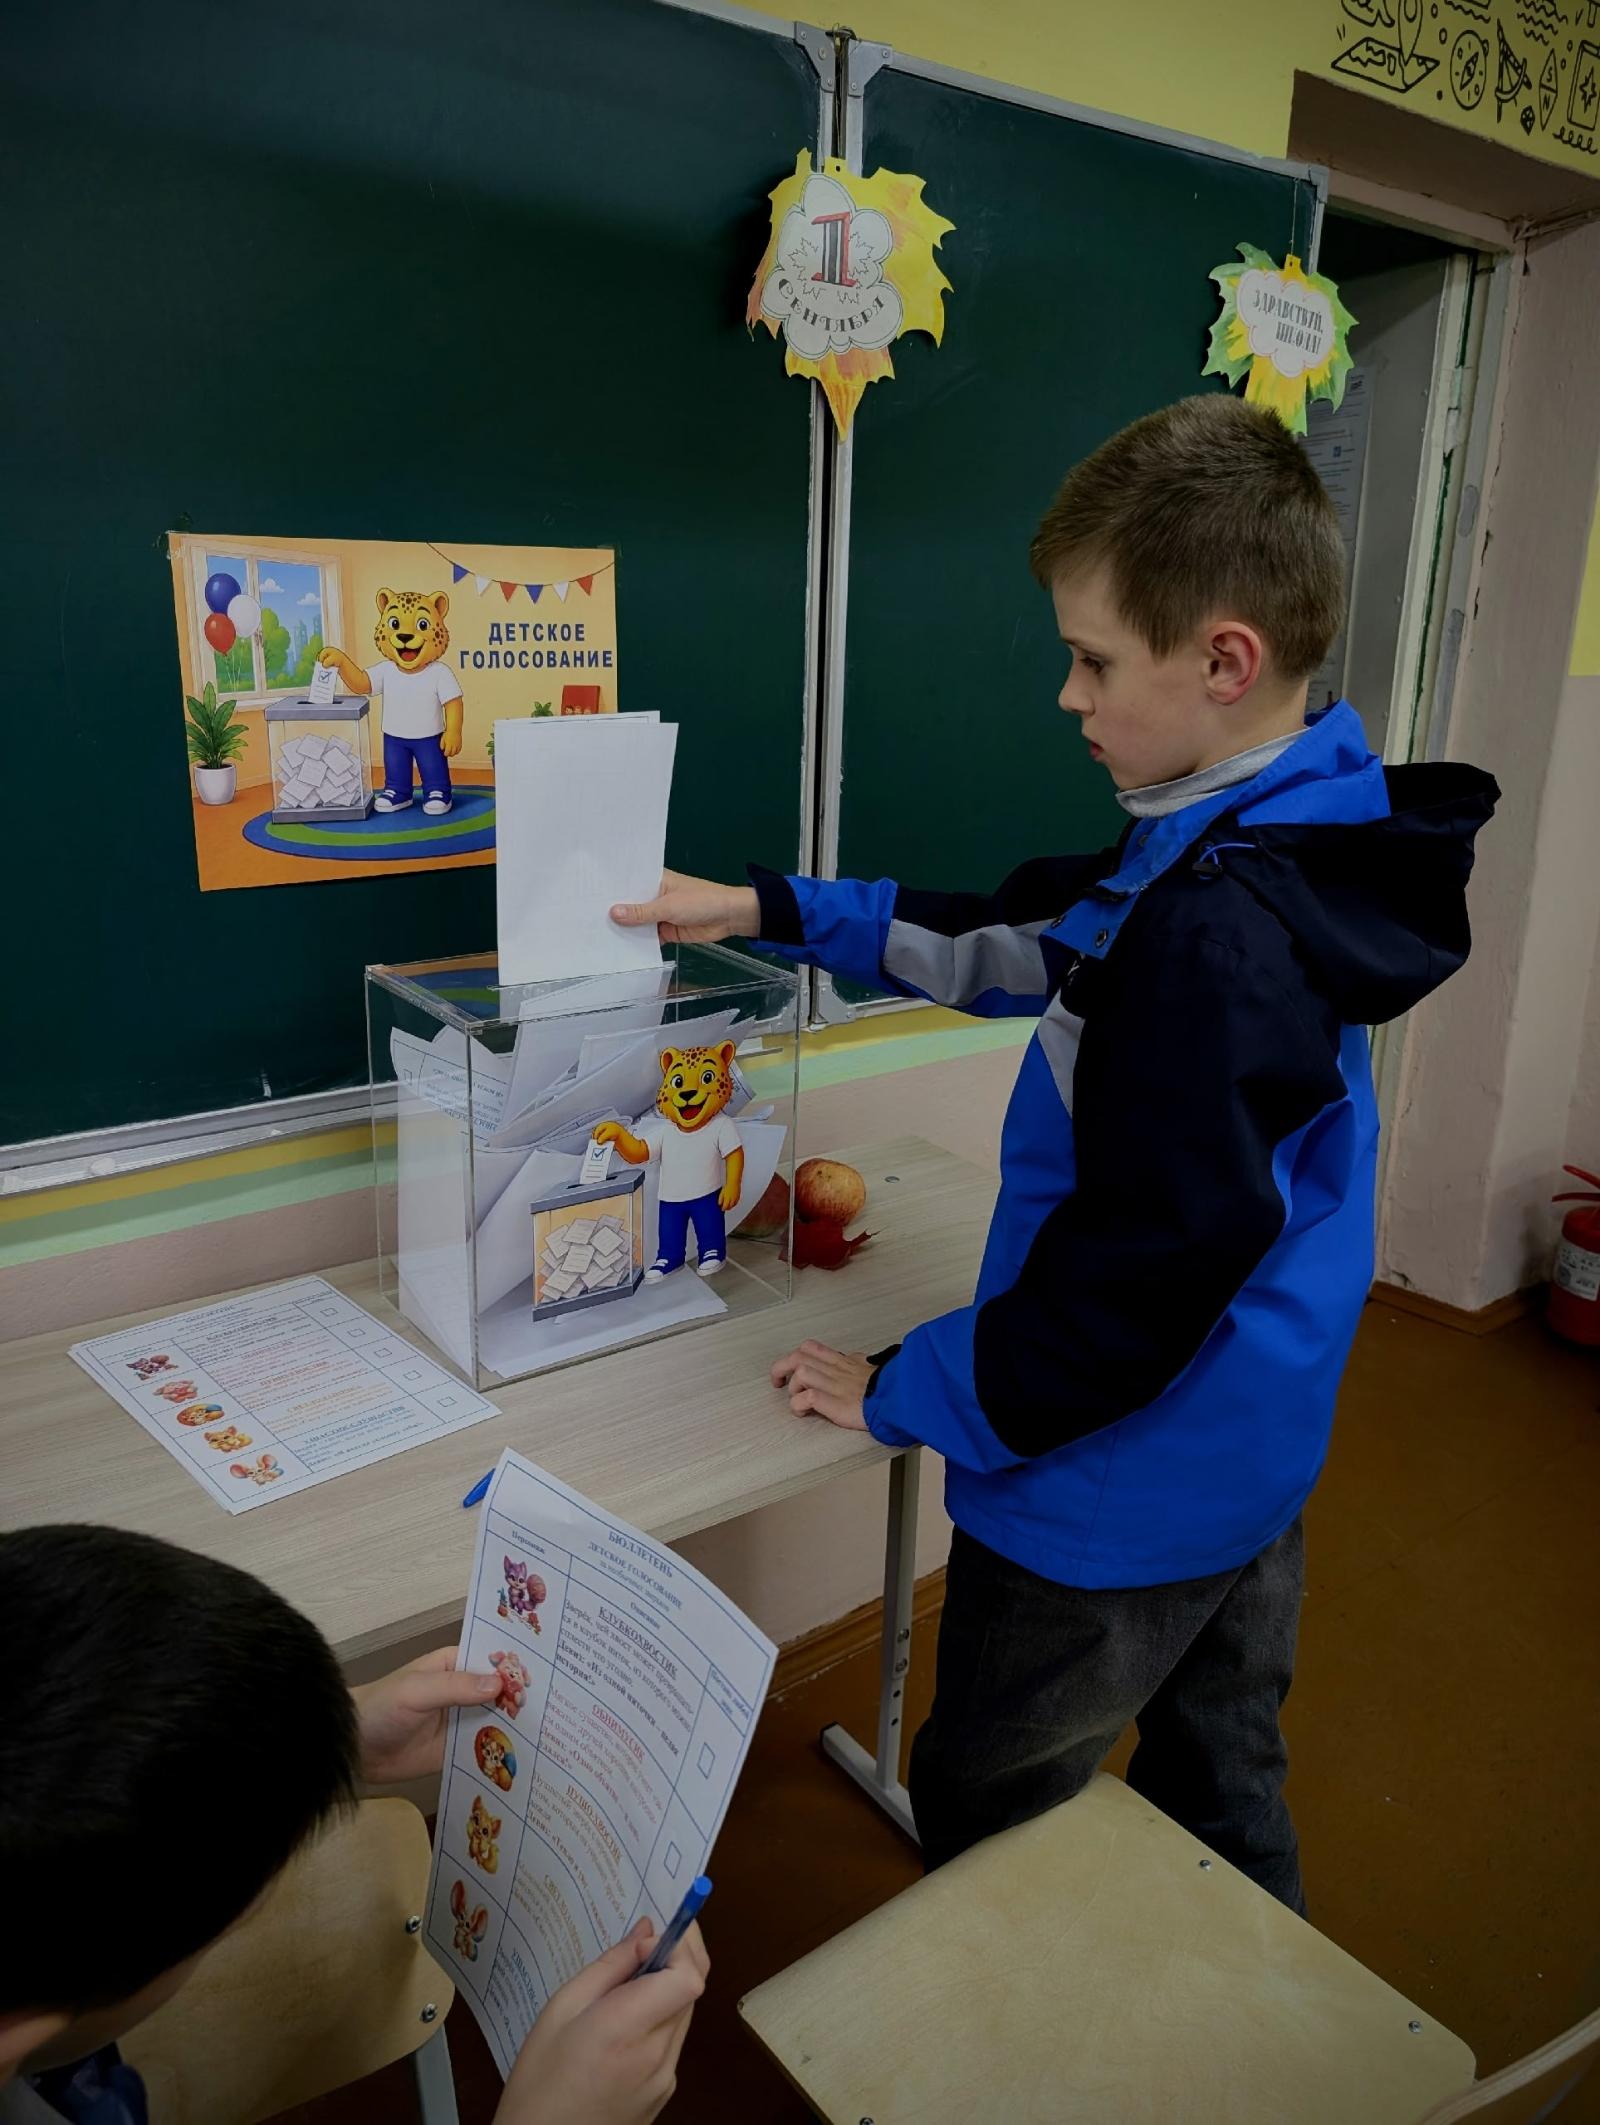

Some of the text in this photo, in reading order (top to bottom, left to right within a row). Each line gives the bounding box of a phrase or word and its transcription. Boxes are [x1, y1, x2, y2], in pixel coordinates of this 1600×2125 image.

[811, 211, 857, 287] 1
[778, 278, 884, 332] СЕНТЯБРЯ
[488, 623, 585, 645] ДЕТСКОЕ
[460, 650, 613, 669] ГОЛОСОВАНИЕ
[587, 1540, 685, 1609] ДЕТСКОЕ ГОЛОСОВАНИЕ
[608, 1532, 673, 1578] БЮЛЛЕТЕНЬ
[579, 1625, 607, 1651] клубок
[598, 1605, 677, 1682] КЛУБКОХВОСТИК
[602, 1671, 626, 1695] одной
[591, 1702, 644, 1766] ОБНИМУСИК
